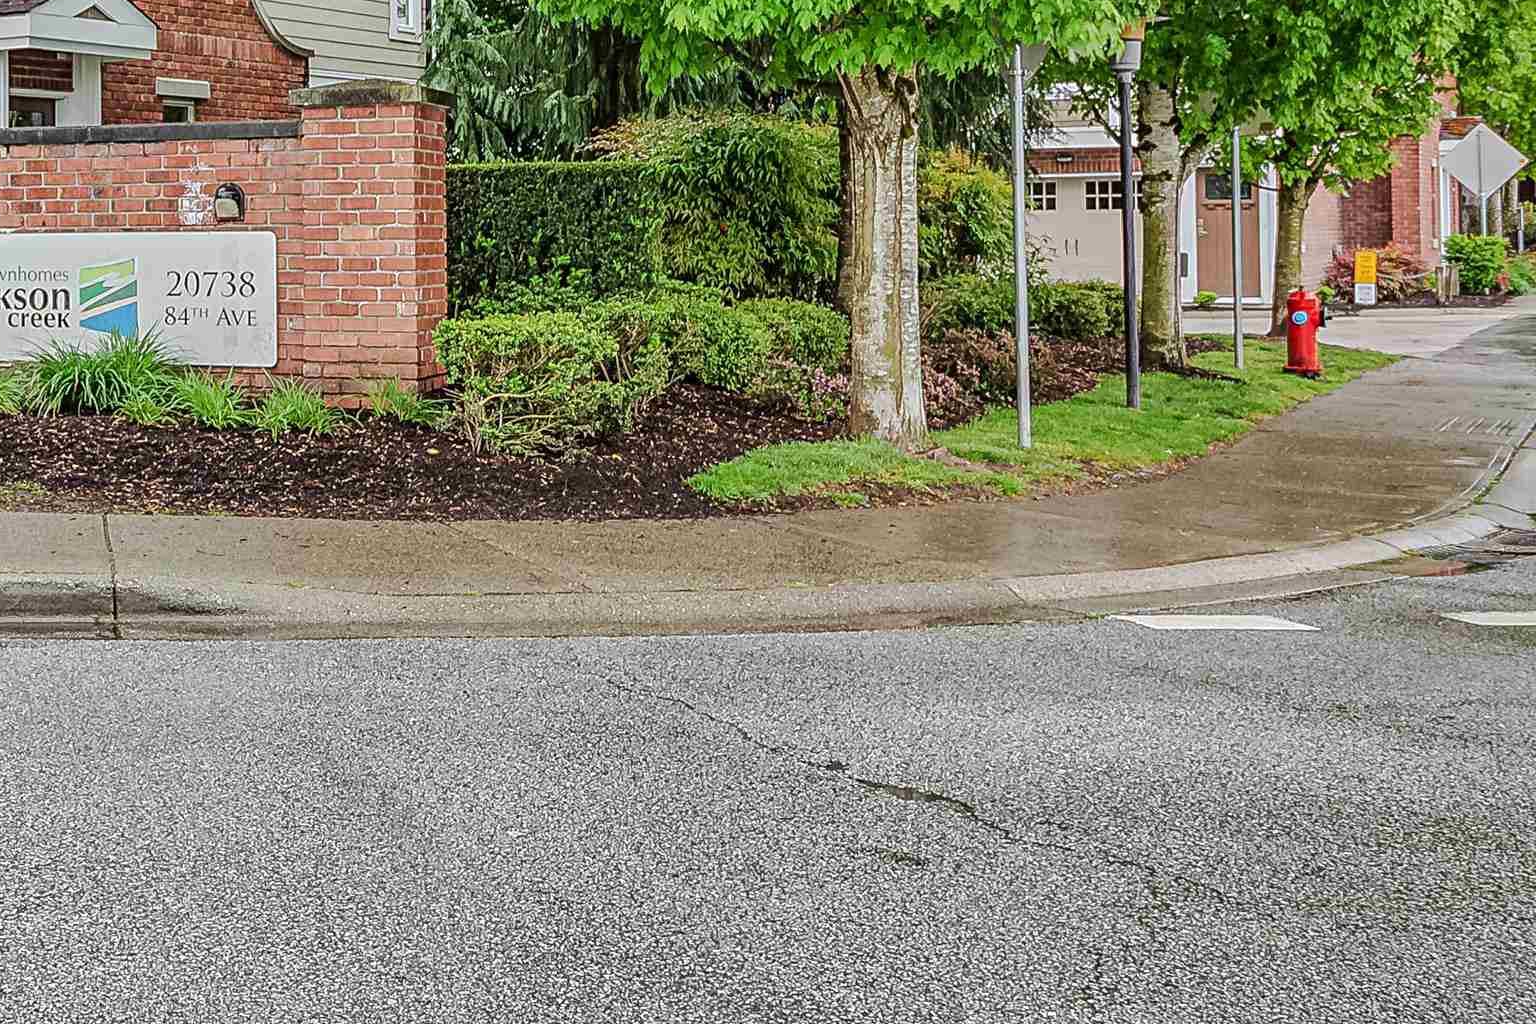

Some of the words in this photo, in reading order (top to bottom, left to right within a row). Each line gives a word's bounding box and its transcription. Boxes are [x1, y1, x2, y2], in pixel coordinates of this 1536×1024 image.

[166, 270, 256, 298] 20738
[7, 311, 71, 328] creek
[164, 306, 209, 326] 84TH
[216, 307, 257, 327] AVE
